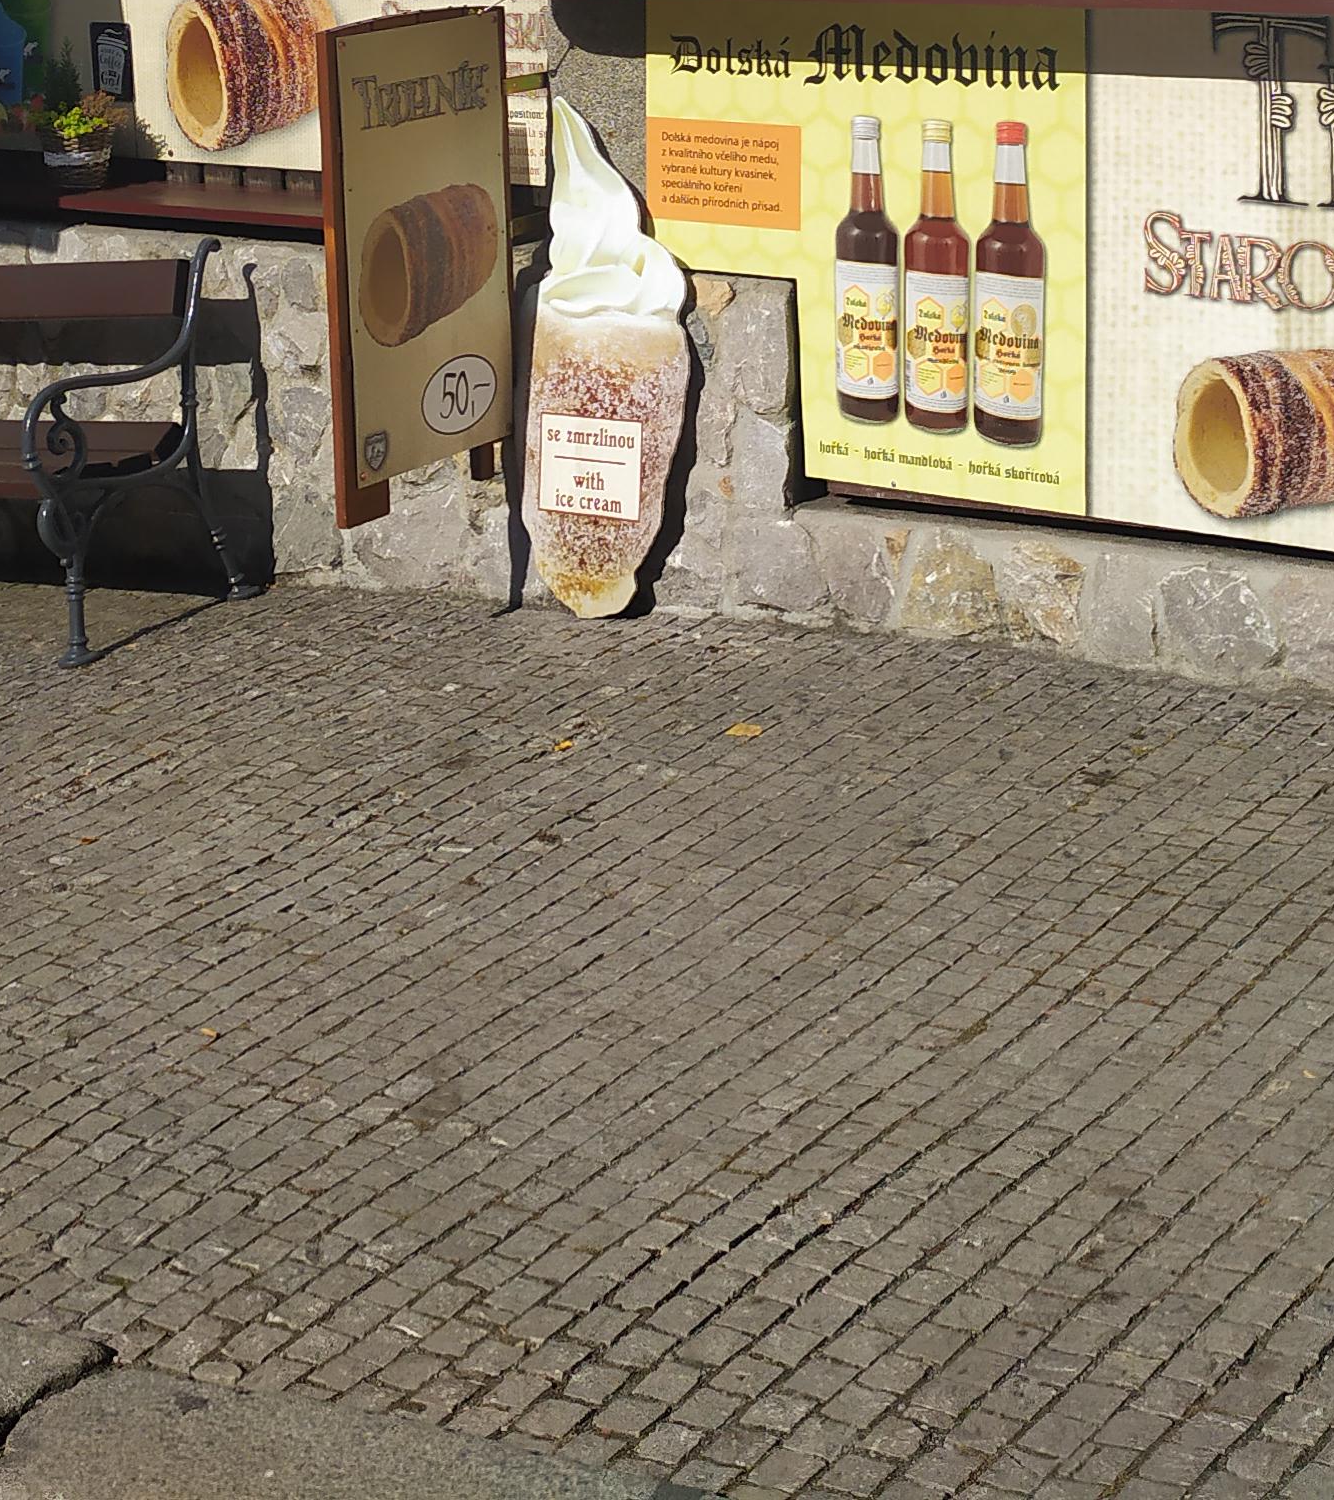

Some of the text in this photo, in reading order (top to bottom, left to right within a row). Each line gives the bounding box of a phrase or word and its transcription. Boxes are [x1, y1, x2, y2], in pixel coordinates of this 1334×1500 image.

[669, 22, 1061, 92] Dolská Medovina
[509, 109, 545, 122] position:
[661, 131, 780, 152] Dolská medovina je nápoj
[668, 148, 713, 160] kvalitního
[749, 154, 780, 166] medu,
[661, 163, 777, 182] vybrané kultury kvasinek,
[661, 195, 667, 203] a
[440, 370, 493, 419] 50,-
[546, 425, 635, 450] se zmrzlinou
[819, 440, 849, 456] hořká
[864, 445, 895, 463] hořká
[898, 452, 953, 471] mandlová
[968, 459, 1001, 477] hořká
[1004, 468, 1060, 485] skořicová
[572, 470, 605, 491] with
[555, 490, 622, 514] ice cream
